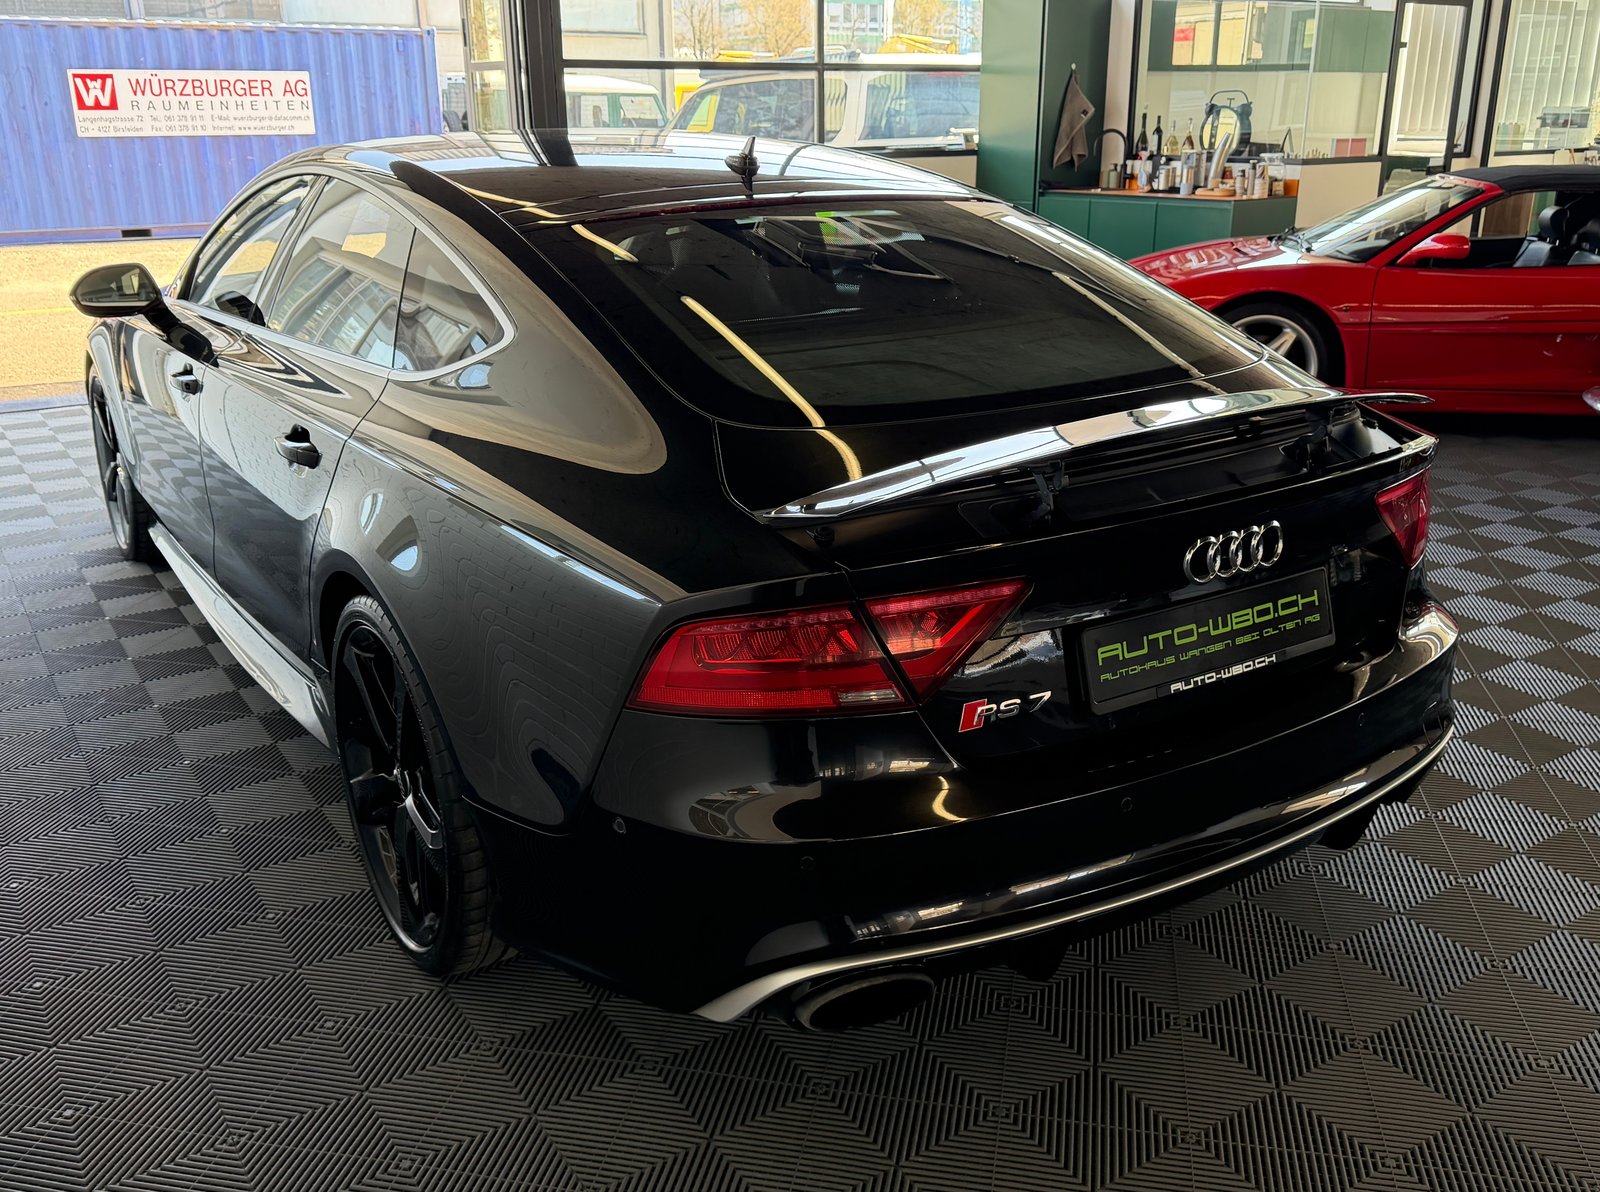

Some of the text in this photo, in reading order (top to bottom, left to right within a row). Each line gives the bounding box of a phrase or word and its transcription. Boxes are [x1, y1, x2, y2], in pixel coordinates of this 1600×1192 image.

[128, 73, 308, 97] WÜRZBURGER AG
[131, 99, 309, 111] RAUMEINHEITEN
[78, 115, 134, 124] Langenhagstrasse
[1100, 613, 1321, 683] AUTOHAUS WANGEN BEI OLTEN AG
